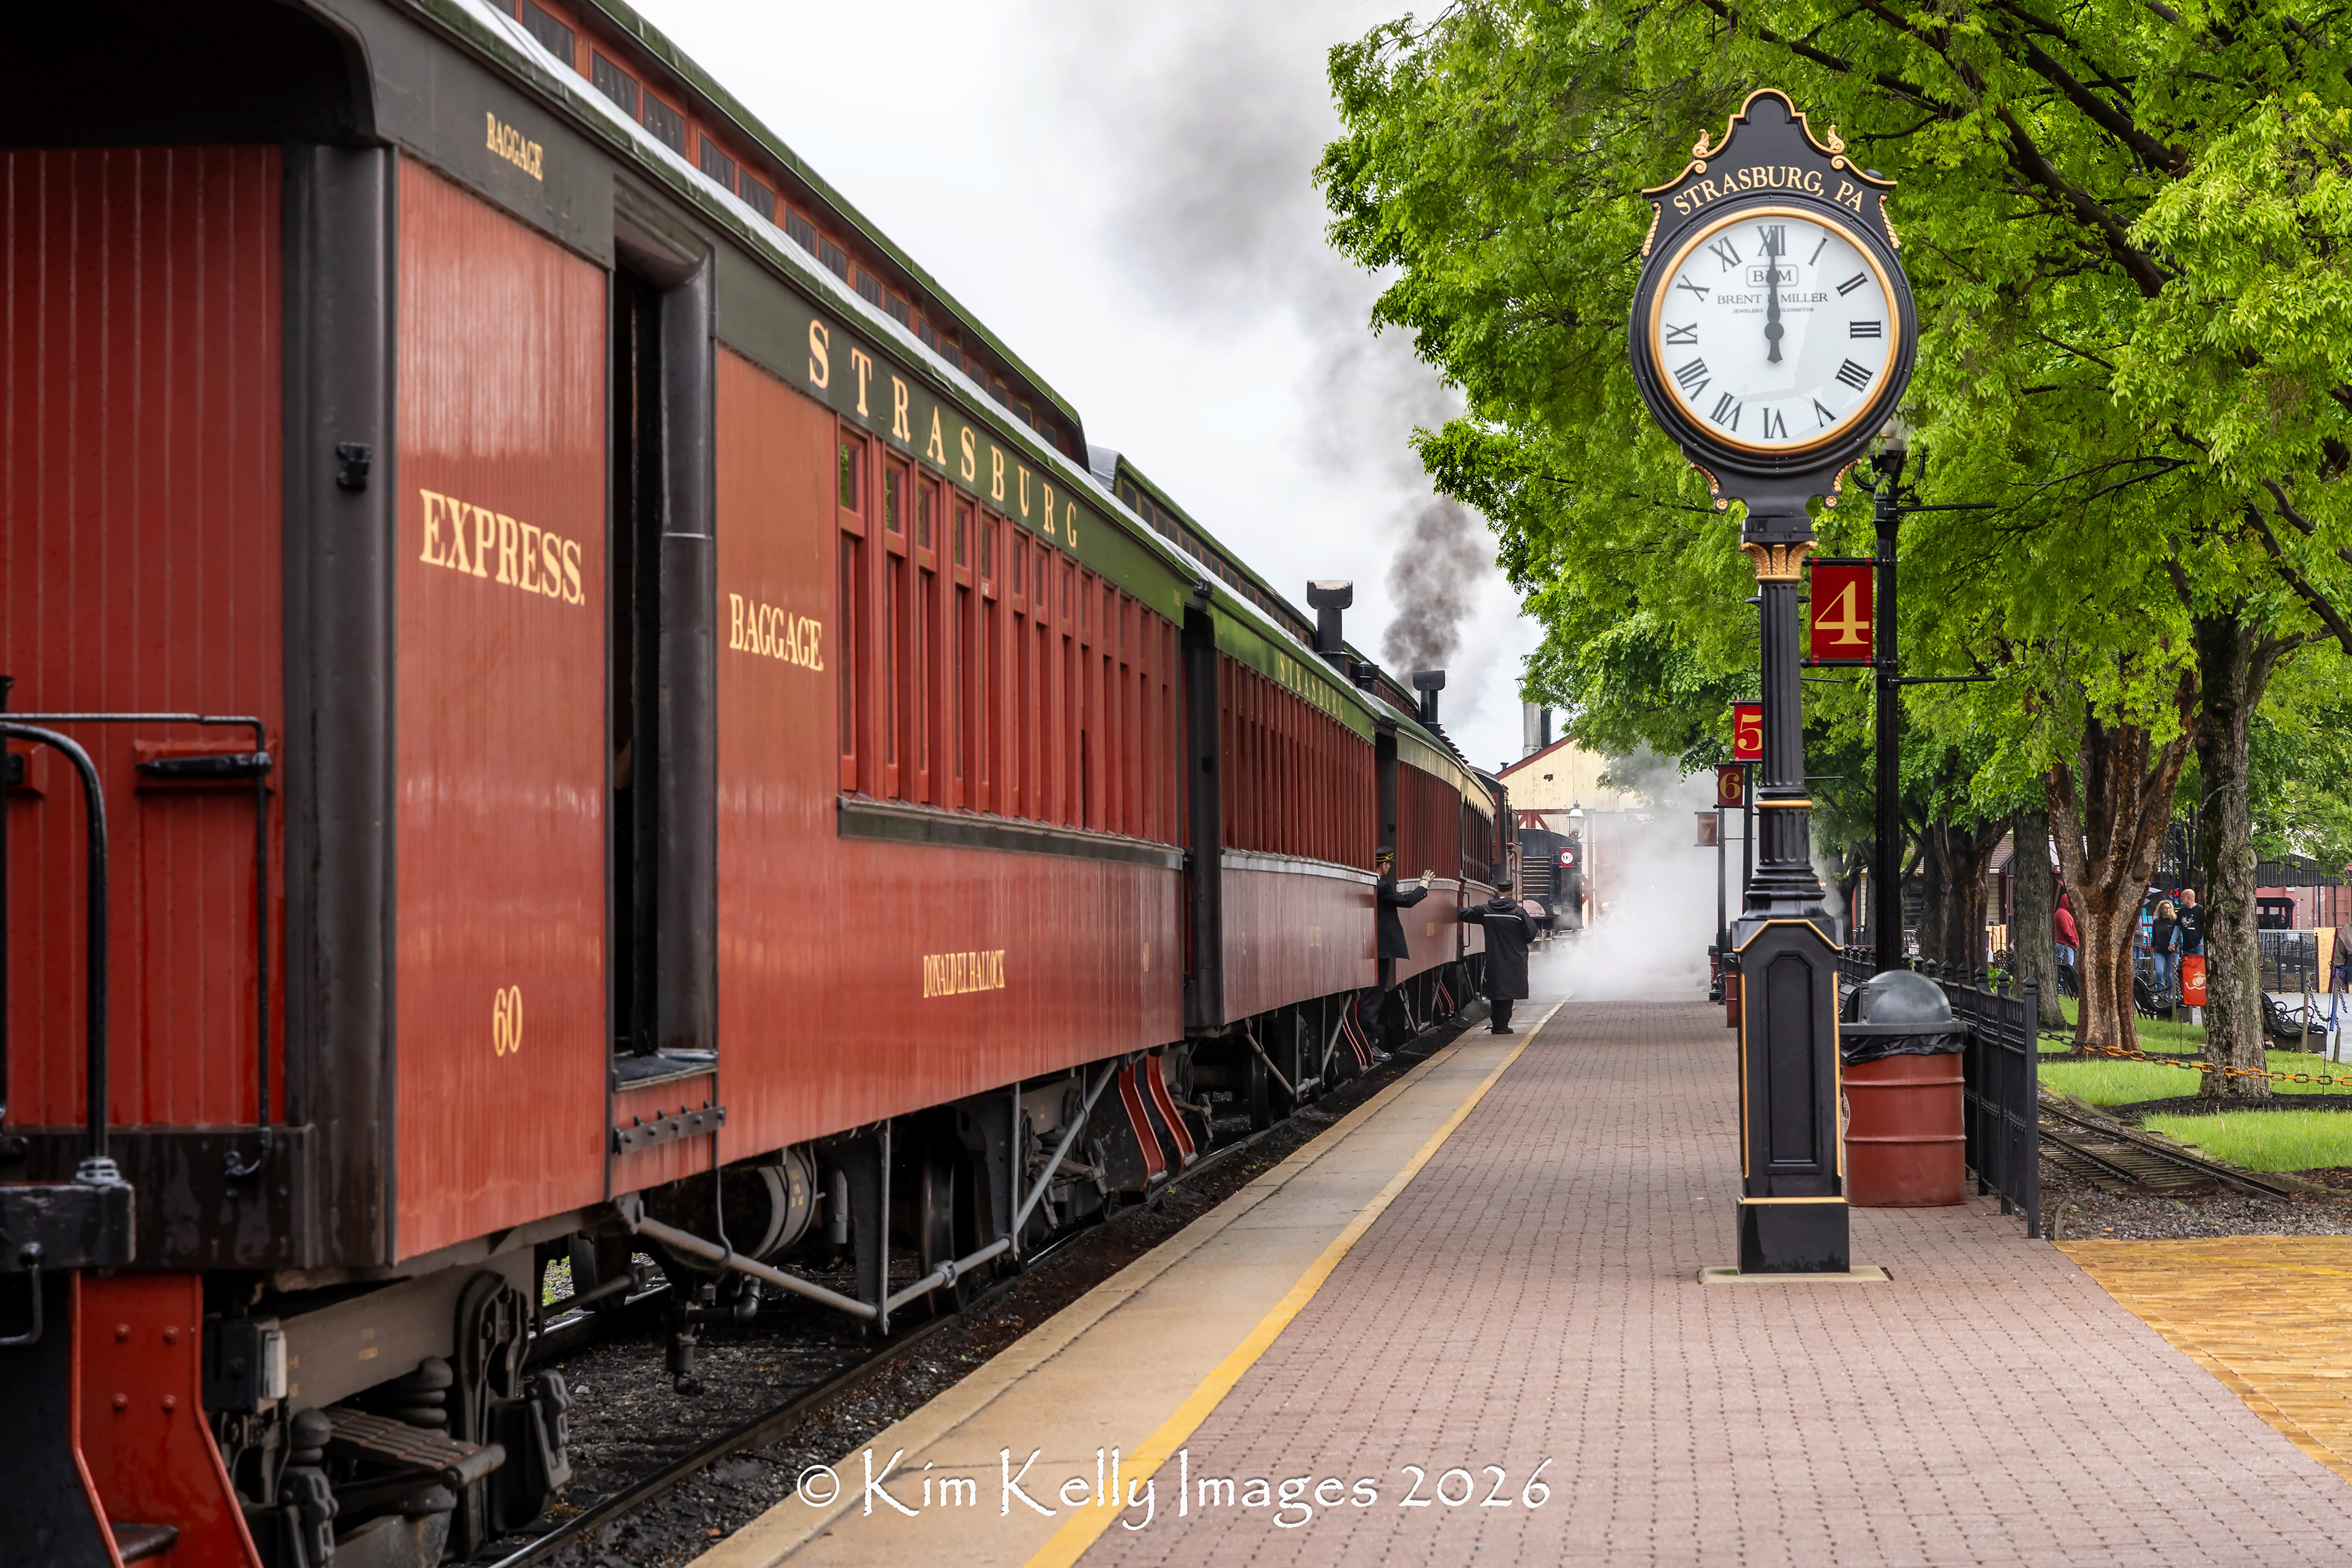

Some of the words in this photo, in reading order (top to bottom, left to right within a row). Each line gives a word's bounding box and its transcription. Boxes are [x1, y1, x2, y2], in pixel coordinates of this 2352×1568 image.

[486, 111, 543, 182] BAGGAGE
[1673, 165, 1825, 216] STRASBURG,
[1834, 179, 1864, 213] PA
[1708, 236, 1743, 273] XI
[1808, 237, 1828, 266] I
[1676, 274, 1711, 303] X
[1753, 270, 1792, 282] BM
[1836, 271, 1869, 298] II
[1717, 294, 1762, 304] BRENT
[1781, 293, 1829, 303] MILLER
[1666, 322, 1698, 345] IX
[1850, 320, 1882, 339] III
[1673, 357, 1713, 402] VIII
[1709, 391, 1743, 432] VII
[1763, 407, 1789, 439] VI
[1813, 398, 1837, 428] V
[809, 319, 1078, 549] STRASBURG
[420, 488, 586, 607] EXPRESS.
[1814, 581, 1870, 645] 4
[729, 592, 824, 672] BAGGAGE
[1280, 652, 1344, 720] STRASBURG
[1737, 714, 1762, 752] 5
[1719, 772, 1742, 799] 6
[1698, 819, 1715, 839] 7
[492, 984, 524, 1057] 60
